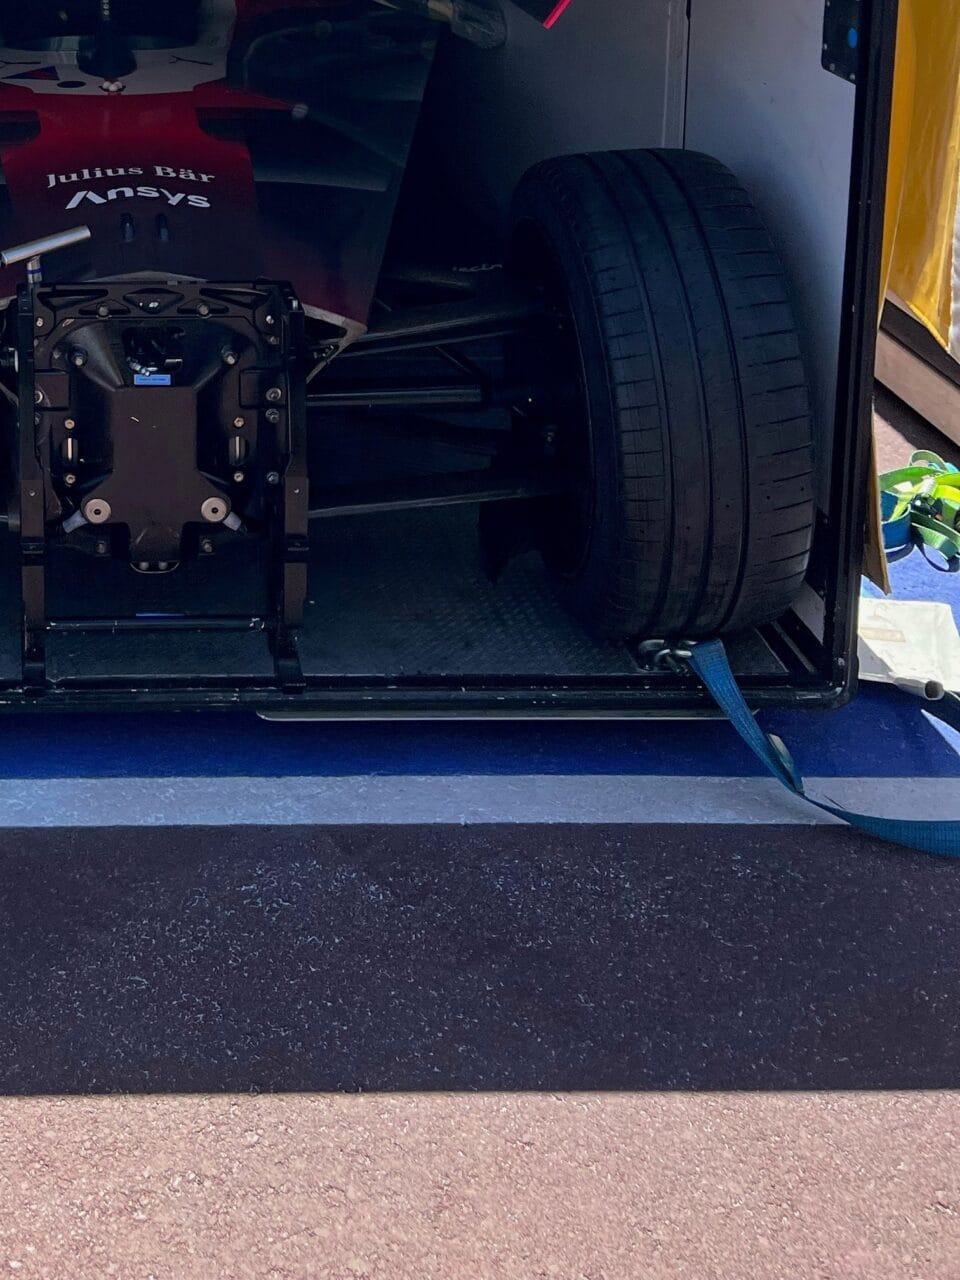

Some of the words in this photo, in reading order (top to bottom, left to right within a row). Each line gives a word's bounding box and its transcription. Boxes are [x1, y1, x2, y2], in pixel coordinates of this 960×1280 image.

[46, 166, 144, 189] Julius
[152, 165, 217, 183] Bär
[65, 186, 211, 210] Ansys
